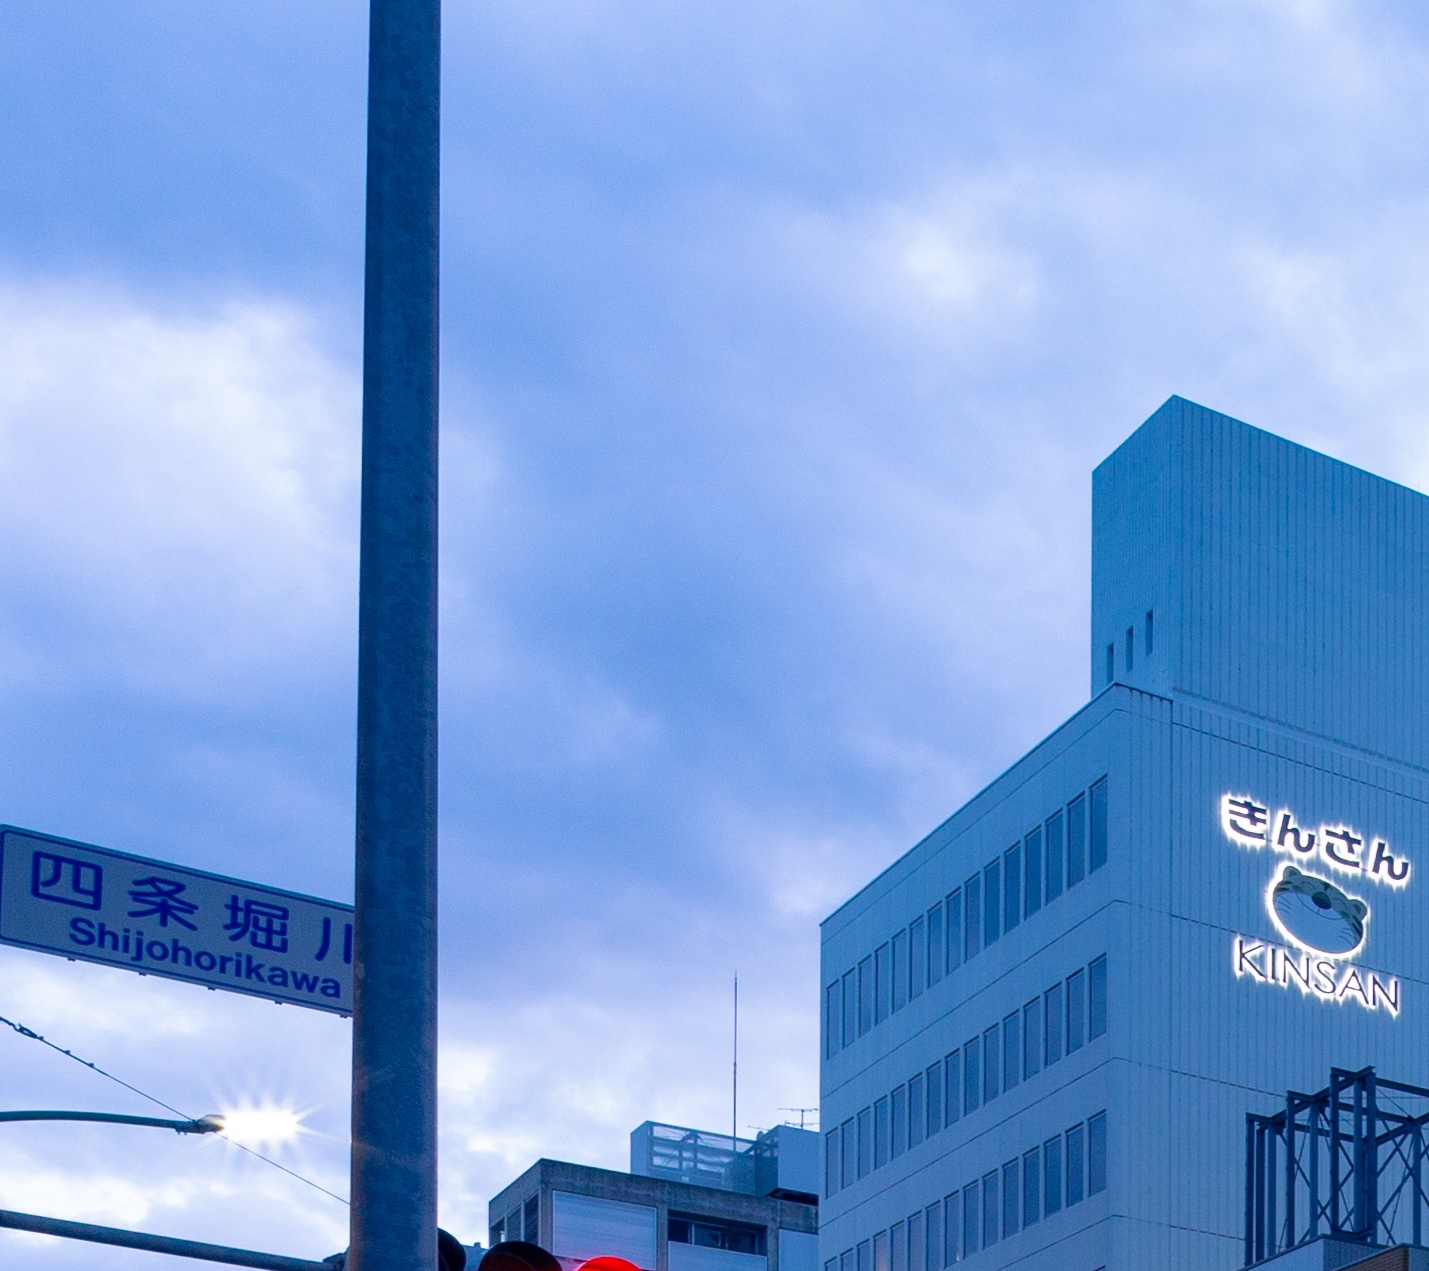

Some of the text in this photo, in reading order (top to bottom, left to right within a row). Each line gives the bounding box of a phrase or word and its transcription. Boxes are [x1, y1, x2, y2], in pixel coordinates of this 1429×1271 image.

[1226, 796, 1410, 884] きんさん
[69, 917, 341, 999] Shijohorikawa
[1237, 938, 1399, 1014] KINSAN
